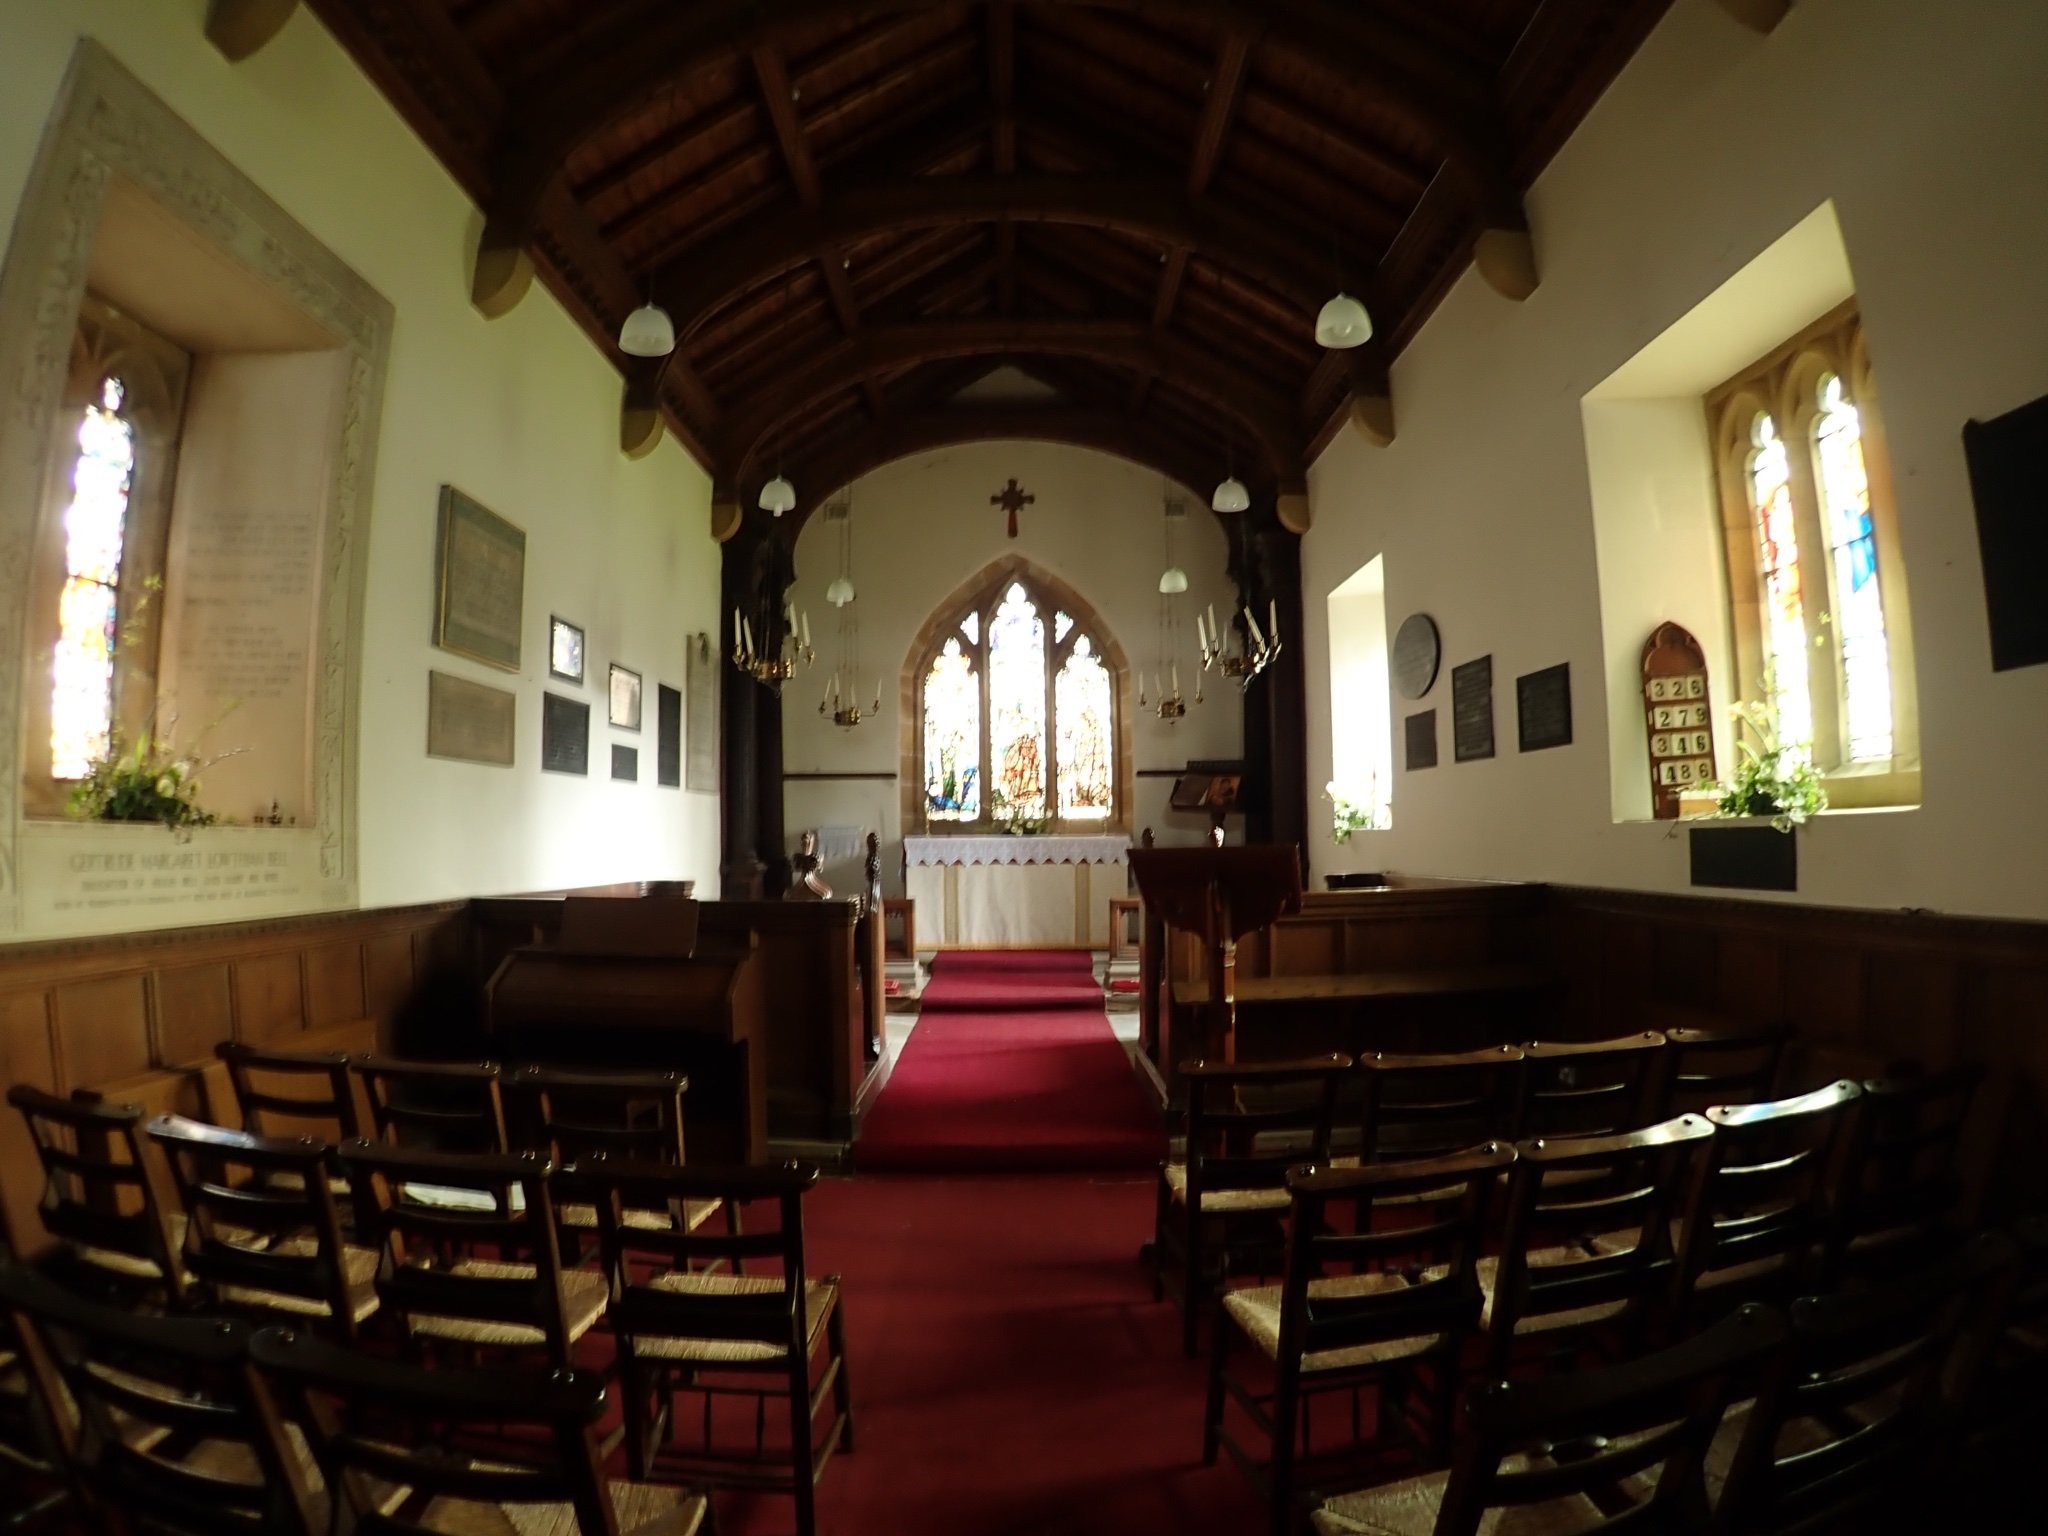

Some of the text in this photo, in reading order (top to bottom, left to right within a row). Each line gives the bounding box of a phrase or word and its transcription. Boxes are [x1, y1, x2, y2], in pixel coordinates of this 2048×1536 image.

[1654, 680, 1701, 697] 326
[1660, 708, 1706, 727] 279
[1657, 735, 1705, 754] 346
[1666, 763, 1709, 783] 486
